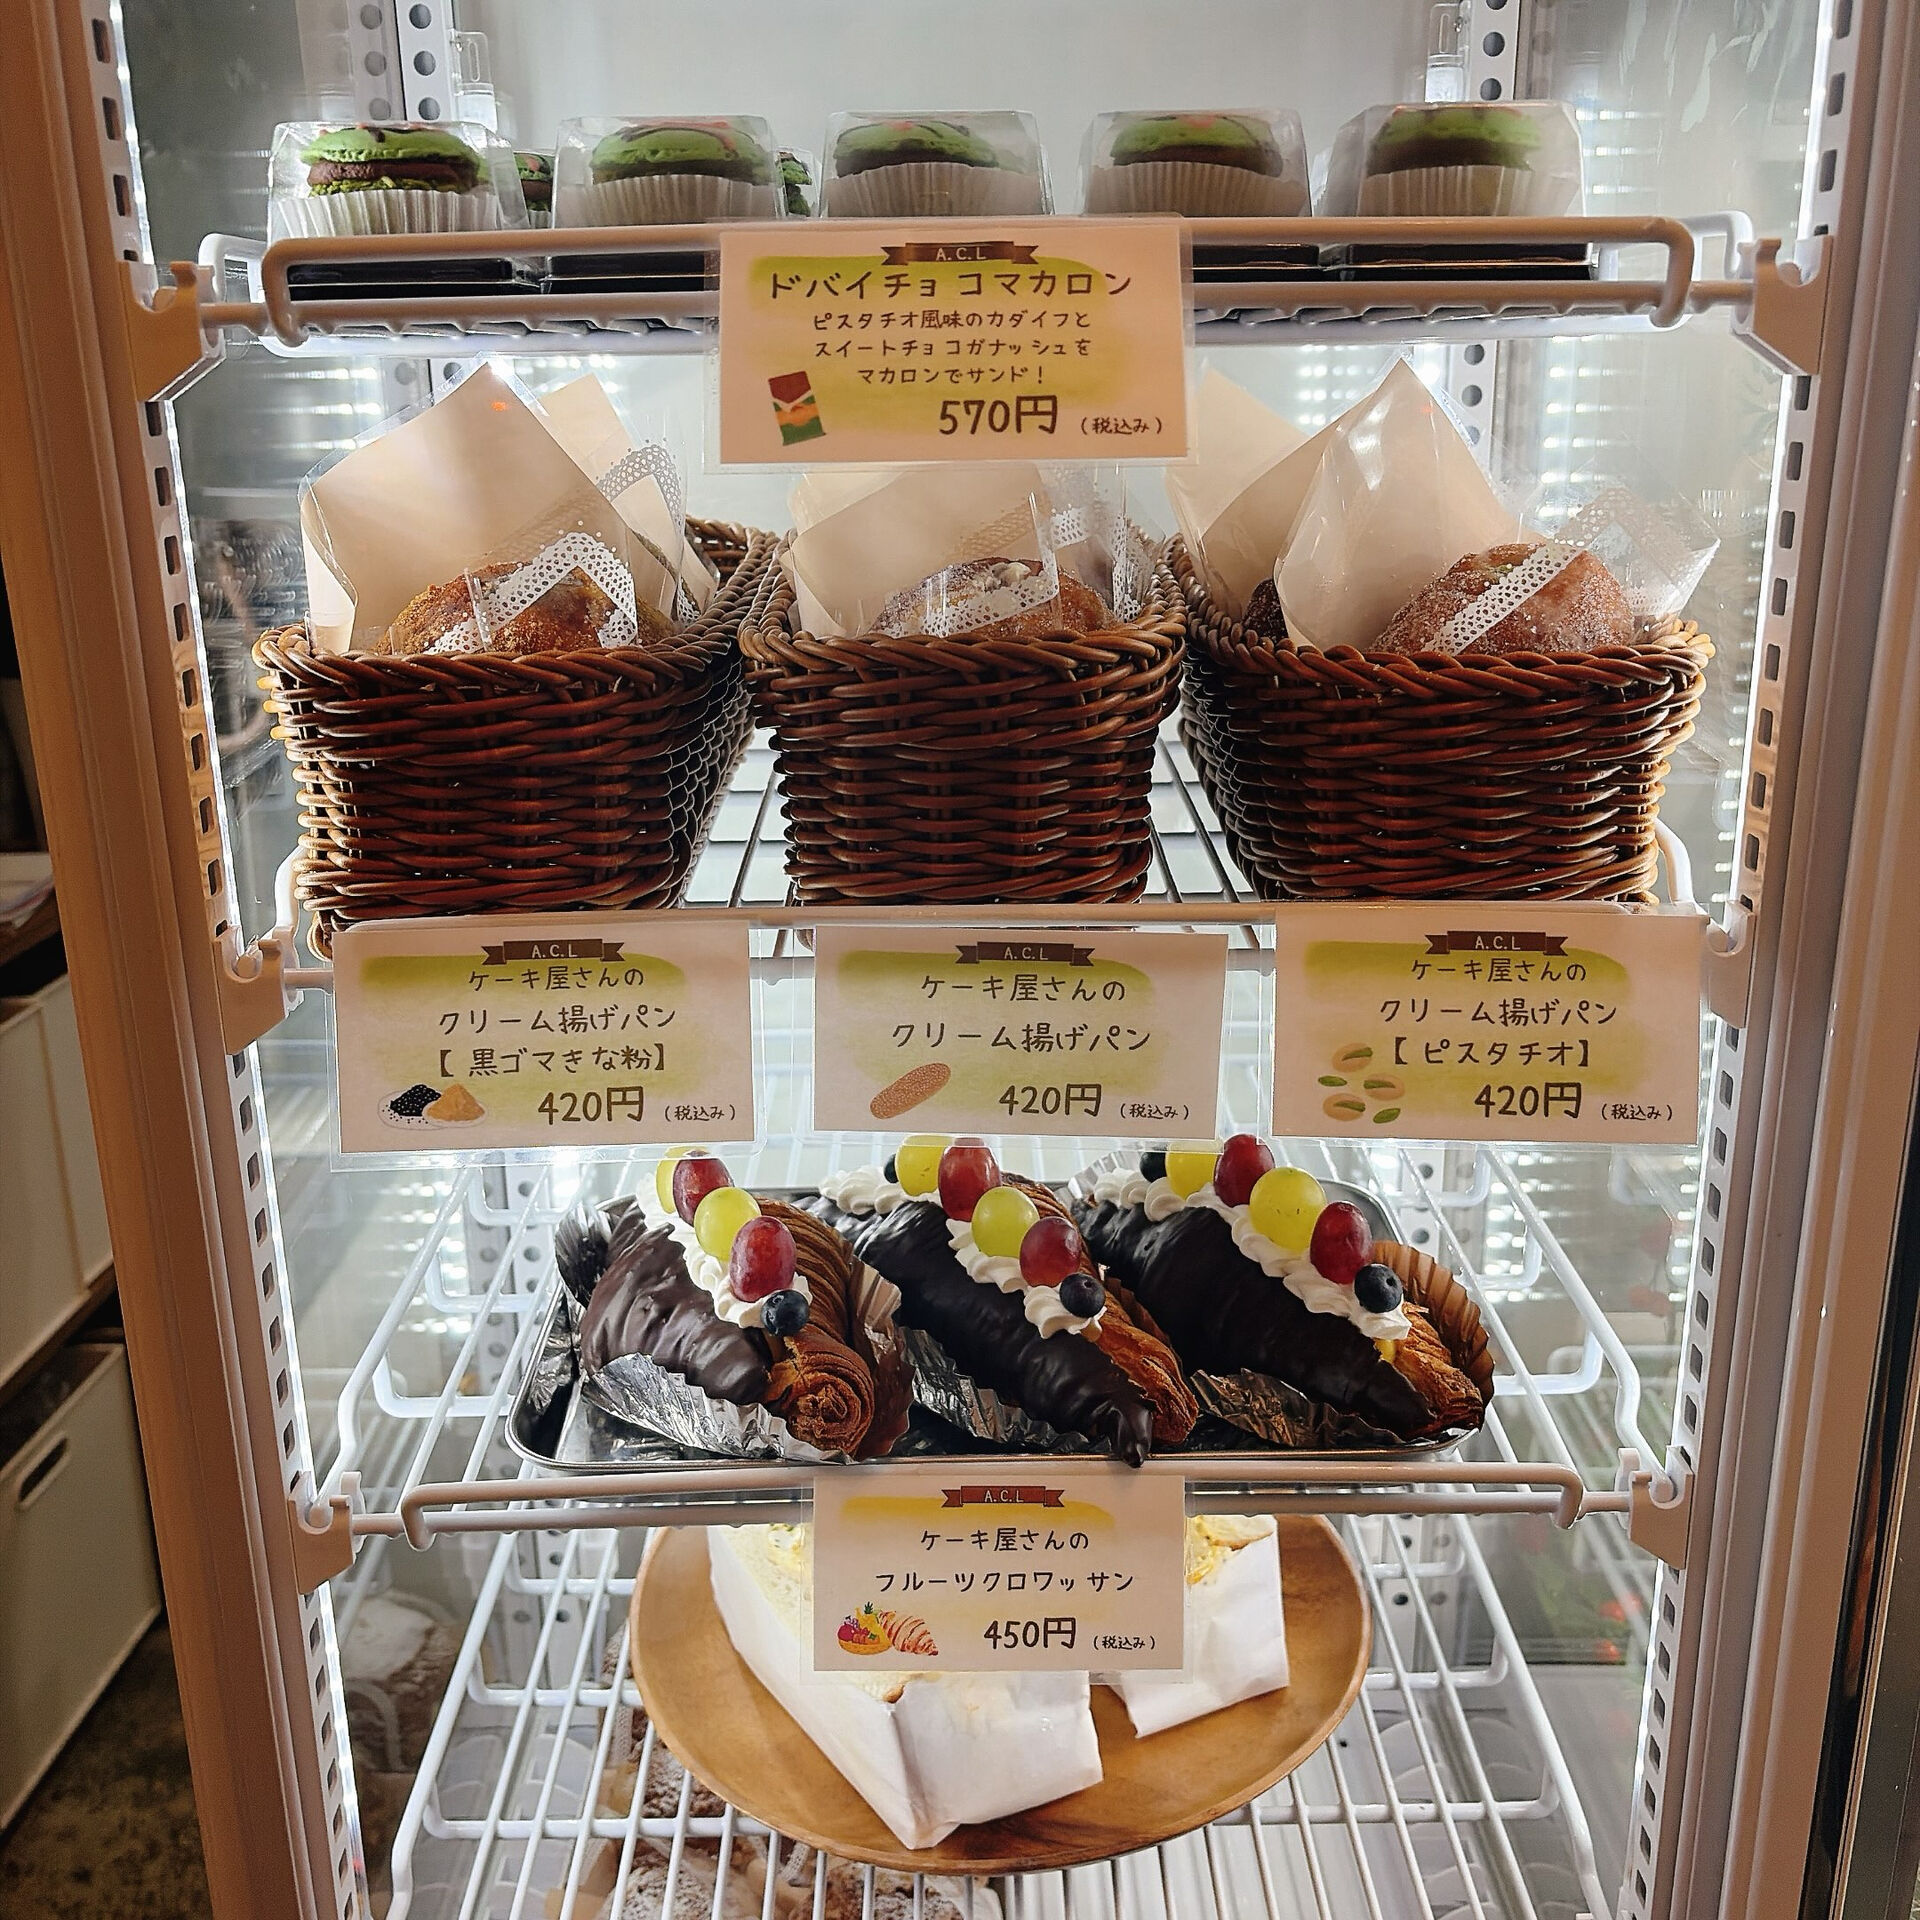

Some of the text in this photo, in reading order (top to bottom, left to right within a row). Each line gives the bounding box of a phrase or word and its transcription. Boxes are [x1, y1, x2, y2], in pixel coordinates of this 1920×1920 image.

[935, 245, 988, 262] A.C.L
[769, 270, 1132, 300] ドバイチョコマカロン
[812, 309, 1092, 331] ピスタチオ風味のカダイフと
[814, 337, 1092, 358] スイートチョコガナッシュを
[857, 365, 1046, 385] マカロンでサンド！
[938, 394, 1059, 436] 570円
[530, 943, 579, 960] A.C.L
[1003, 945, 1049, 962] A.C.L
[1474, 935, 1522, 951] A.C.L
[468, 965, 645, 992] ケーキ屋さんの
[1410, 957, 1588, 984] ケーキ屋さんの
[920, 973, 1126, 1002] ケーキ屋さんの
[438, 1003, 678, 1036] クリーム揚げパン
[1379, 998, 1618, 1027] クリーム揚げパン
[891, 1021, 1152, 1054] クリーム揚げパン
[537, 1085, 645, 1126] 420円
[998, 1082, 1103, 1117] 420円
[1473, 1081, 1582, 1120] 420円
[983, 1488, 1025, 1504] A.C.L
[920, 1527, 1089, 1552] ケーキ屋さんの
[875, 1571, 1135, 1593] フルーツクロワッサン
[982, 1616, 1077, 1650] 450円
